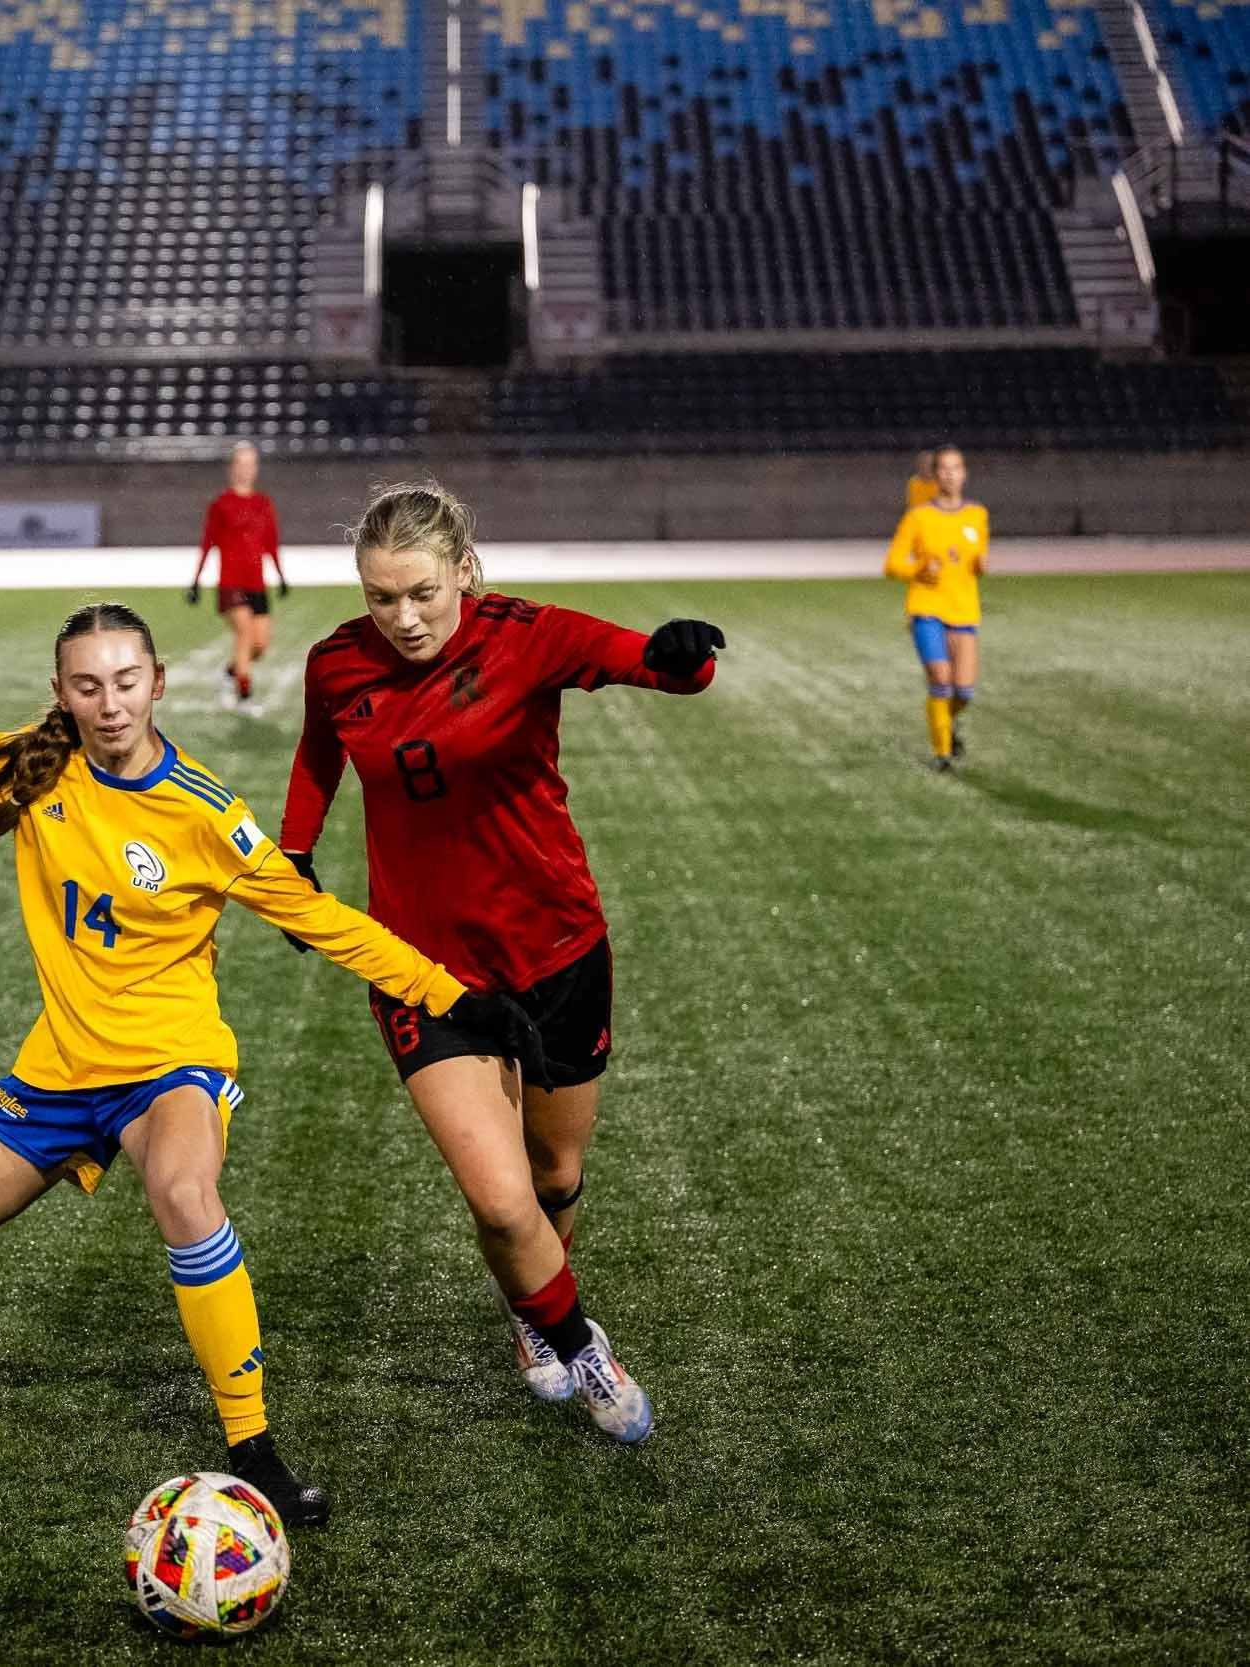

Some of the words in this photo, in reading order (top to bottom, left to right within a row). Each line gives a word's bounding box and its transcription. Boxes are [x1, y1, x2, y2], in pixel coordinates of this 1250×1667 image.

[394, 740, 447, 803] 8
[62, 880, 122, 948] 14
[391, 1007, 420, 1056] 8
